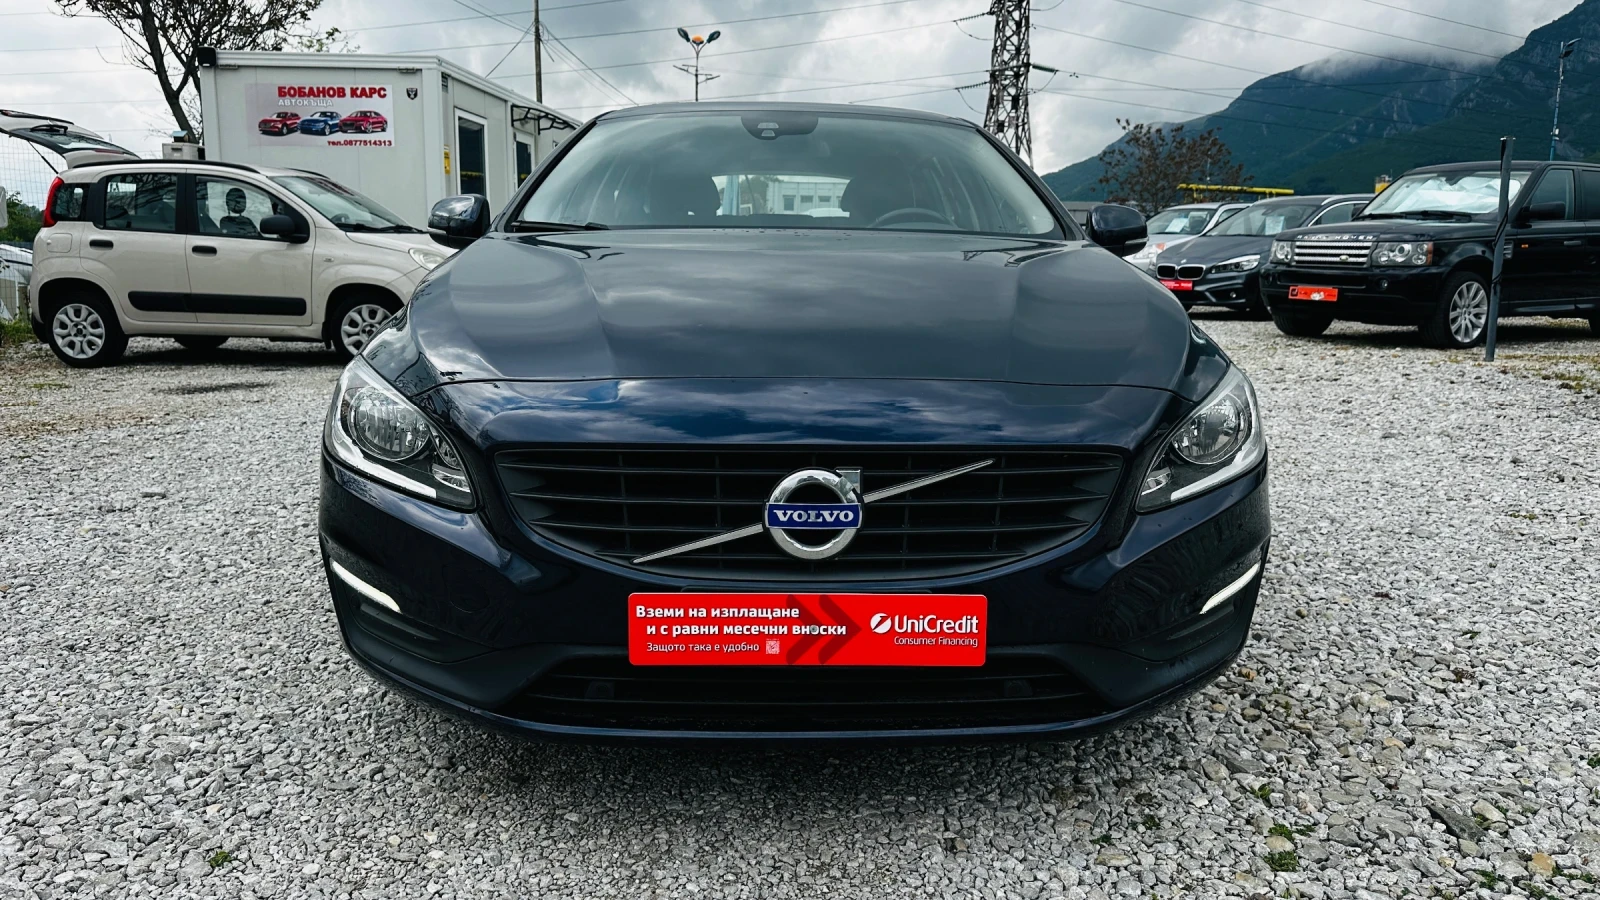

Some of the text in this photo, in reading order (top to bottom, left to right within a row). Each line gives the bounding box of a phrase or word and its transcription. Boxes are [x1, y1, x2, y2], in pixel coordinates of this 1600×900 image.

[277, 86, 388, 99] БОБАНОВ КАРС
[278, 99, 334, 107] АВТОКЪЩА
[773, 509, 854, 522] VOLVO
[635, 605, 800, 620] Вземи на изплащане
[894, 614, 979, 634] UniCredit
[646, 624, 847, 638] и с равни месечни вноски
[646, 642, 760, 654] Защото така е удобно
[894, 636, 979, 648] Consumer Financing
